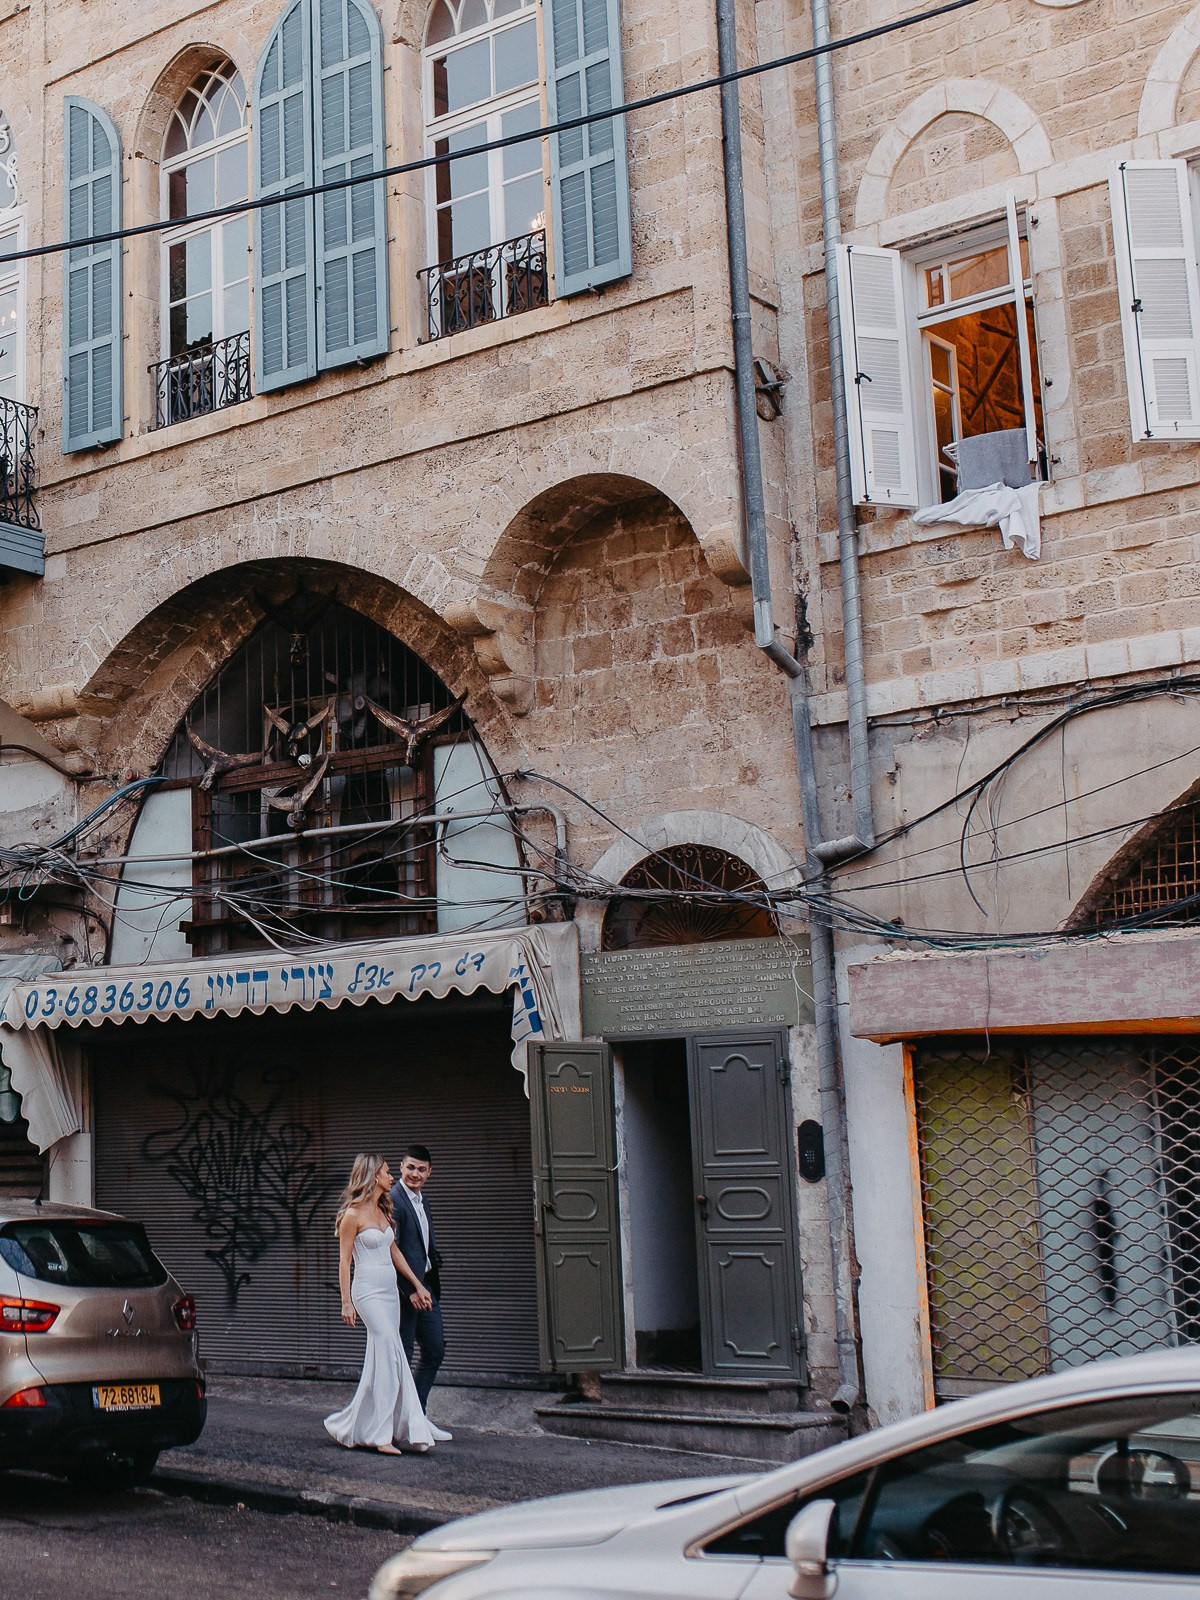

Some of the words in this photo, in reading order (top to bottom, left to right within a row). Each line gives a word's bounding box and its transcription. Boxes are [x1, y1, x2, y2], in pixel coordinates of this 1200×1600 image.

[455, 952, 486, 976] דג
[281, 962, 334, 1001] צורי
[347, 962, 394, 994] אצל
[409, 962, 441, 993] רק
[607, 986, 626, 994] FIRST
[628, 984, 651, 992] OFFICE
[679, 975, 752, 988] ANGLO-PALESTINE
[754, 969, 793, 982] COMPANY
[205, 970, 269, 1010] הדייג
[658, 991, 672, 999] THE
[674, 989, 698, 998] JEWISH
[702, 986, 736, 996] COLONIAL
[739, 984, 761, 993] TRUST
[619, 1002, 664, 1013] ESTABLISHED
[666, 1001, 675, 1009] BY
[692, 996, 732, 1008] THEODOR
[736, 993, 765, 1004] HERZL
[643, 1011, 667, 1021] BANK
[670, 1009, 695, 1019] LEUMI
[618, 1023, 644, 1032] OPENED
[646, 1022, 655, 1030] IN
[677, 1019, 711, 1030] BUILDING
[713, 1018, 723, 1026] ON
[747, 1015, 766, 1023] JULY
